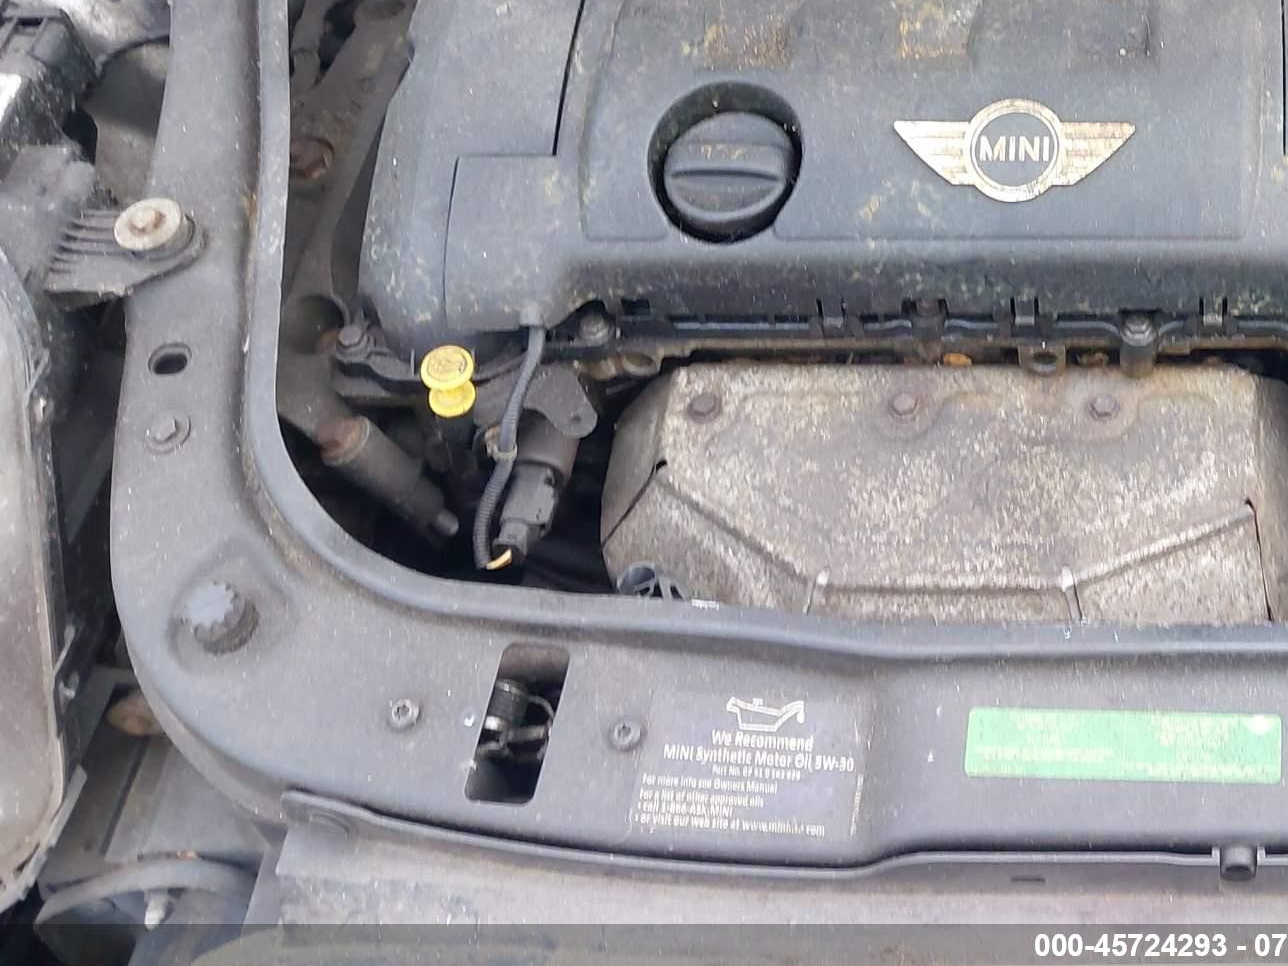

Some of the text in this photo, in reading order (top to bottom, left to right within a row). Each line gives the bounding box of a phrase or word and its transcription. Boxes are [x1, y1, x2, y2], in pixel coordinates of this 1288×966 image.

[979, 135, 1050, 162] MINI
[711, 729, 814, 753] We Recommend
[663, 744, 854, 772] MINI Synthetic Motor Oil 5W-30
[642, 773, 656, 785] For
[657, 776, 679, 788] more
[746, 780, 778, 794] Manual
[652, 812, 672, 826] visit
[672, 815, 690, 827] our
[691, 816, 711, 829] web
